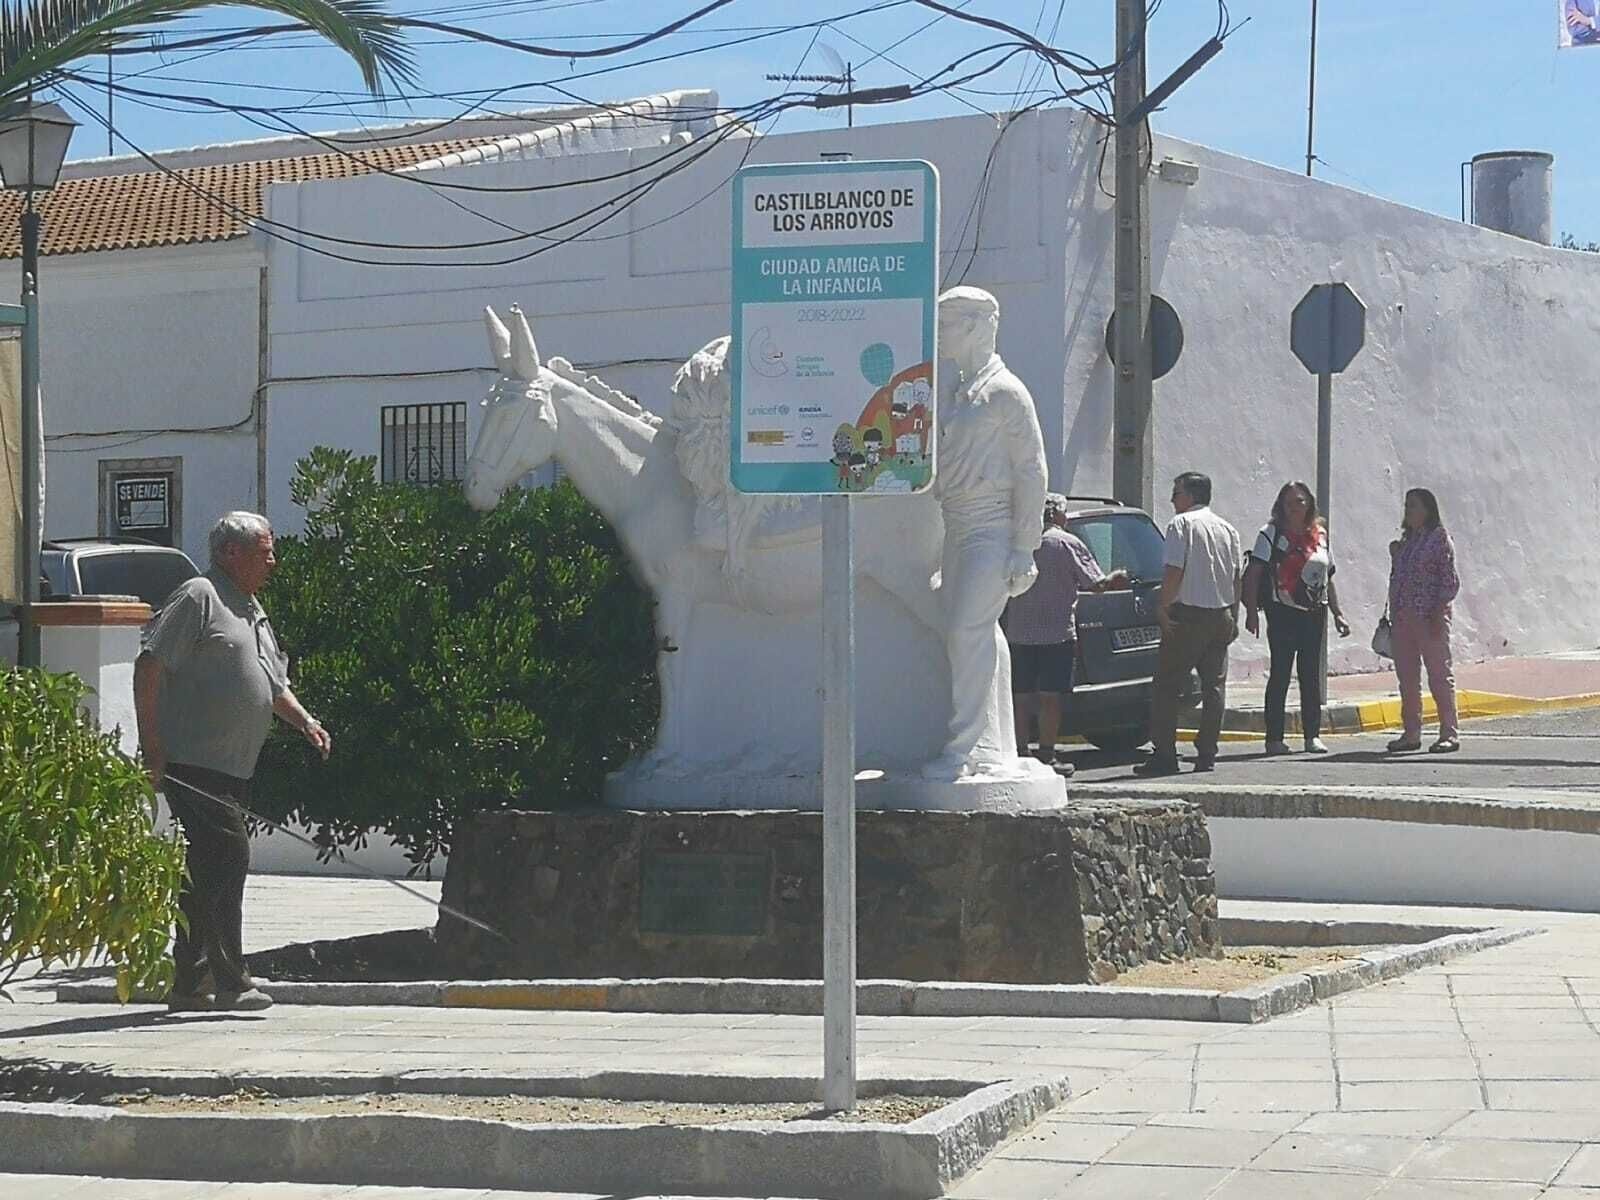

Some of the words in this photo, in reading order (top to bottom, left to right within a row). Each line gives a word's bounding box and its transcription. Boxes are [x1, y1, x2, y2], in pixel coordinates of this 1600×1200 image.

[754, 190, 886, 212] CASTILBLANCO
[891, 188, 914, 207] DE
[773, 214, 805, 232] LOS
[810, 210, 894, 231] ARROYOS
[760, 258, 820, 276] CIUDAD
[825, 257, 880, 274] AMIGA
[885, 255, 906, 272] DE
[783, 280, 802, 295] LA
[807, 276, 883, 295] INFANCIA
[797, 307, 866, 322] 2018-2022
[747, 404, 779, 416] unicef
[119, 485, 131, 500] SE
[132, 484, 165, 499] VENDE
